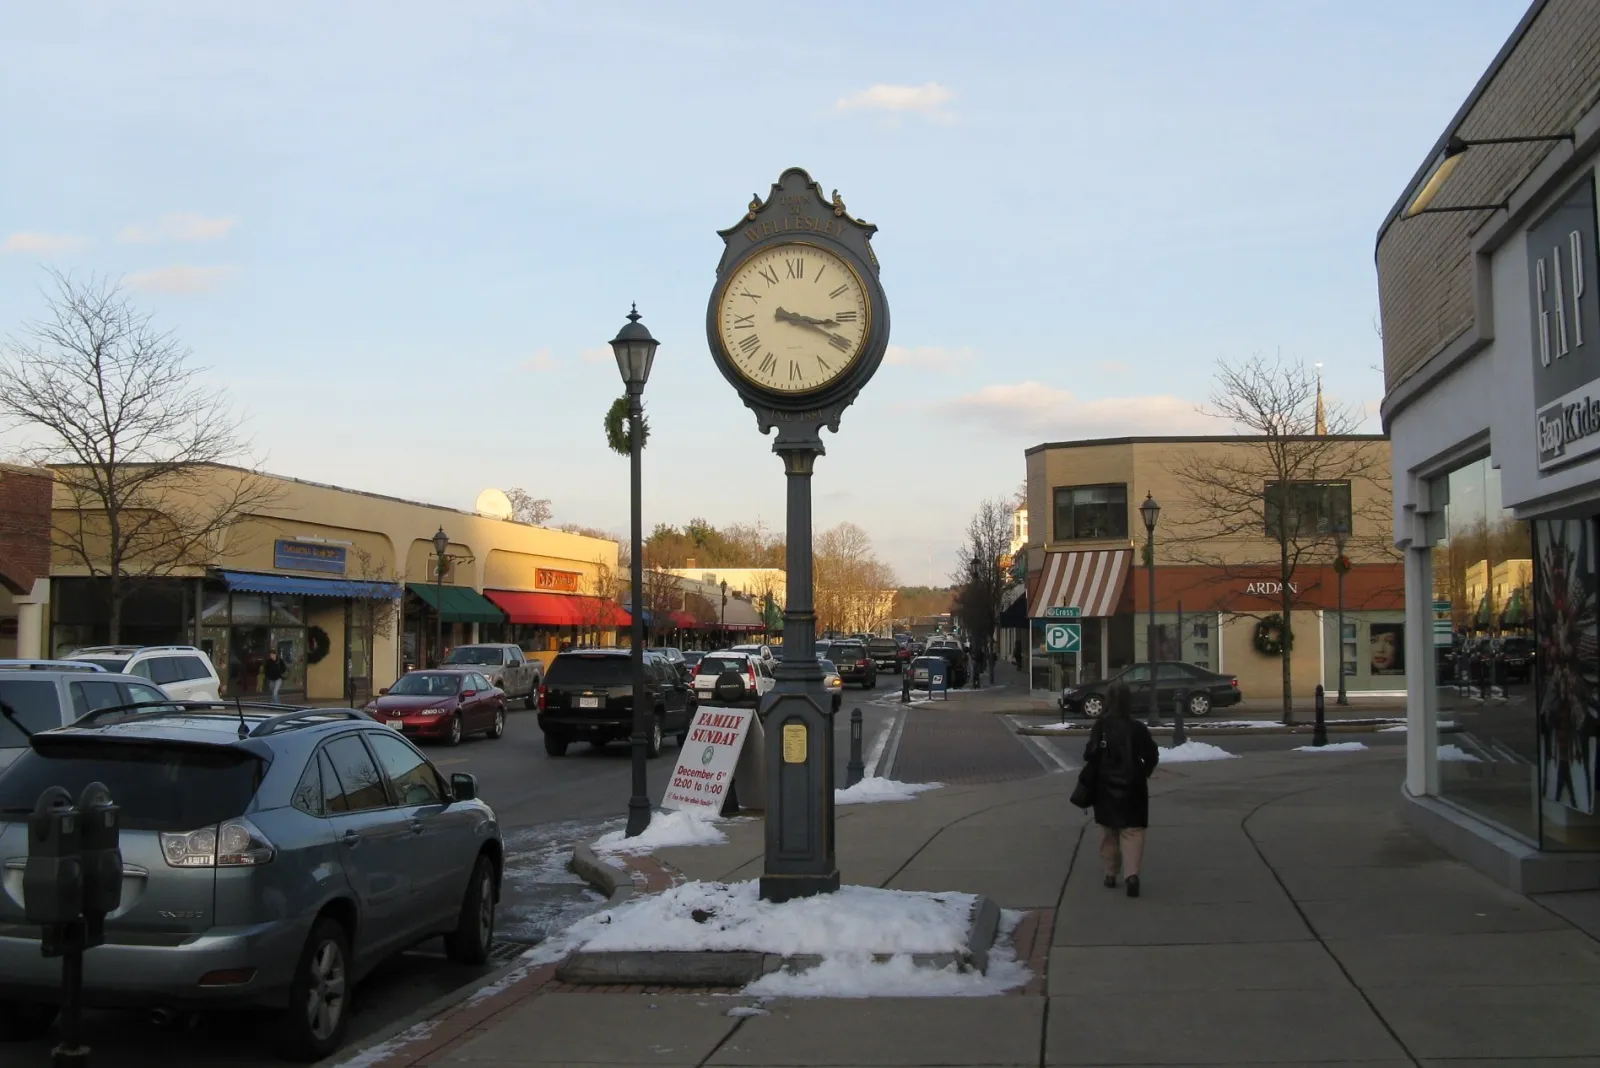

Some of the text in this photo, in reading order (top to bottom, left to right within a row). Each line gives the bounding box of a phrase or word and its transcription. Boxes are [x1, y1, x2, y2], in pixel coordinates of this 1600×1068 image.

[744, 215, 848, 243] WELLESLEY
[758, 264, 779, 288] XI
[785, 258, 803, 279] XII
[814, 264, 826, 283] I
[740, 287, 762, 304] X
[829, 284, 849, 299] II
[1536, 229, 1585, 368] GAP
[734, 314, 755, 329] IX
[836, 311, 857, 322] III
[738, 334, 762, 360] VIII
[758, 352, 778, 377] VII
[789, 360, 803, 381] VI
[816, 355, 831, 373] V
[1537, 396, 1600, 456] GapKids
[1246, 582, 1298, 595] ARDAN
[1055, 608, 1073, 616] Cross
[1053, 629, 1064, 646] P
[697, 713, 744, 729] FAMILY
[691, 728, 739, 746] SUNDAY
[678, 765, 714, 780] December
[673, 777, 692, 789] 12:00
[694, 781, 702, 791] to
